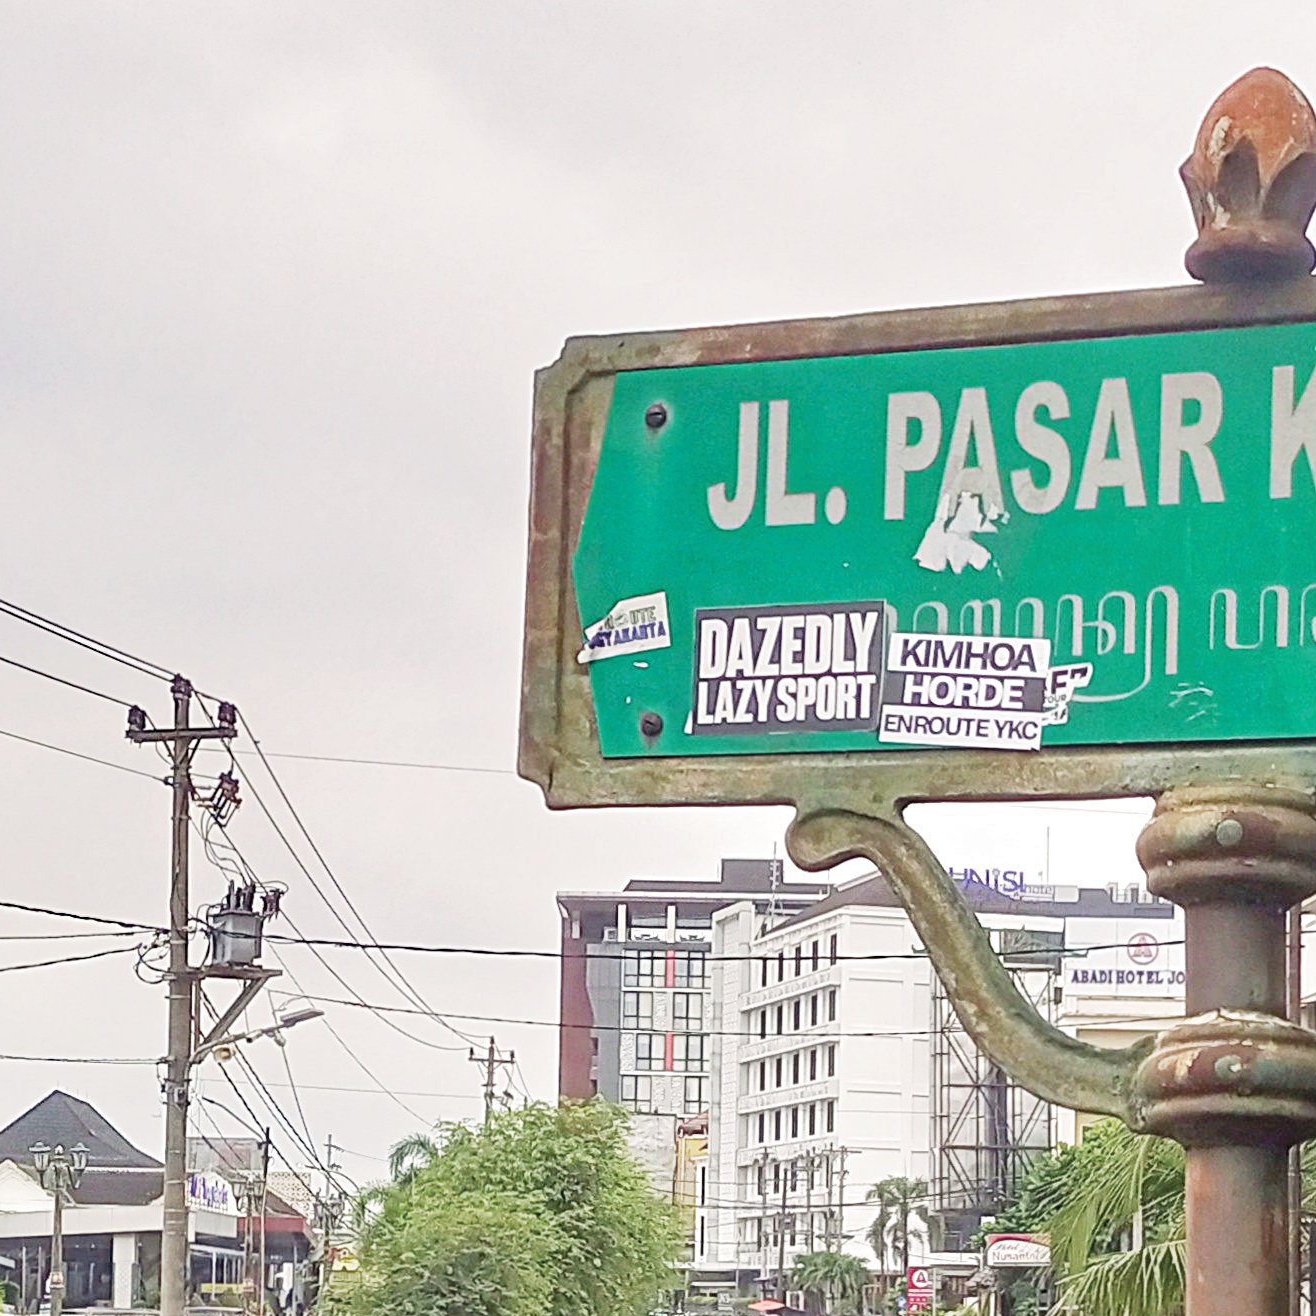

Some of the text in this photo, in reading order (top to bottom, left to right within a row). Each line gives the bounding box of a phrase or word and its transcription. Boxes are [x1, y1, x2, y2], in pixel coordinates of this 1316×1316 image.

[706, 400, 846, 531] JL.
[884, 372, 1226, 520] PASAR
[698, 611, 879, 679] DAZEDLY
[900, 638, 1037, 672] KIMHOA
[902, 673, 1025, 710] HORDE
[884, 713, 1039, 740] ENROUTE YKC
[1071, 970, 1113, 984] ABADI
[1117, 970, 1163, 985] HOTEL
